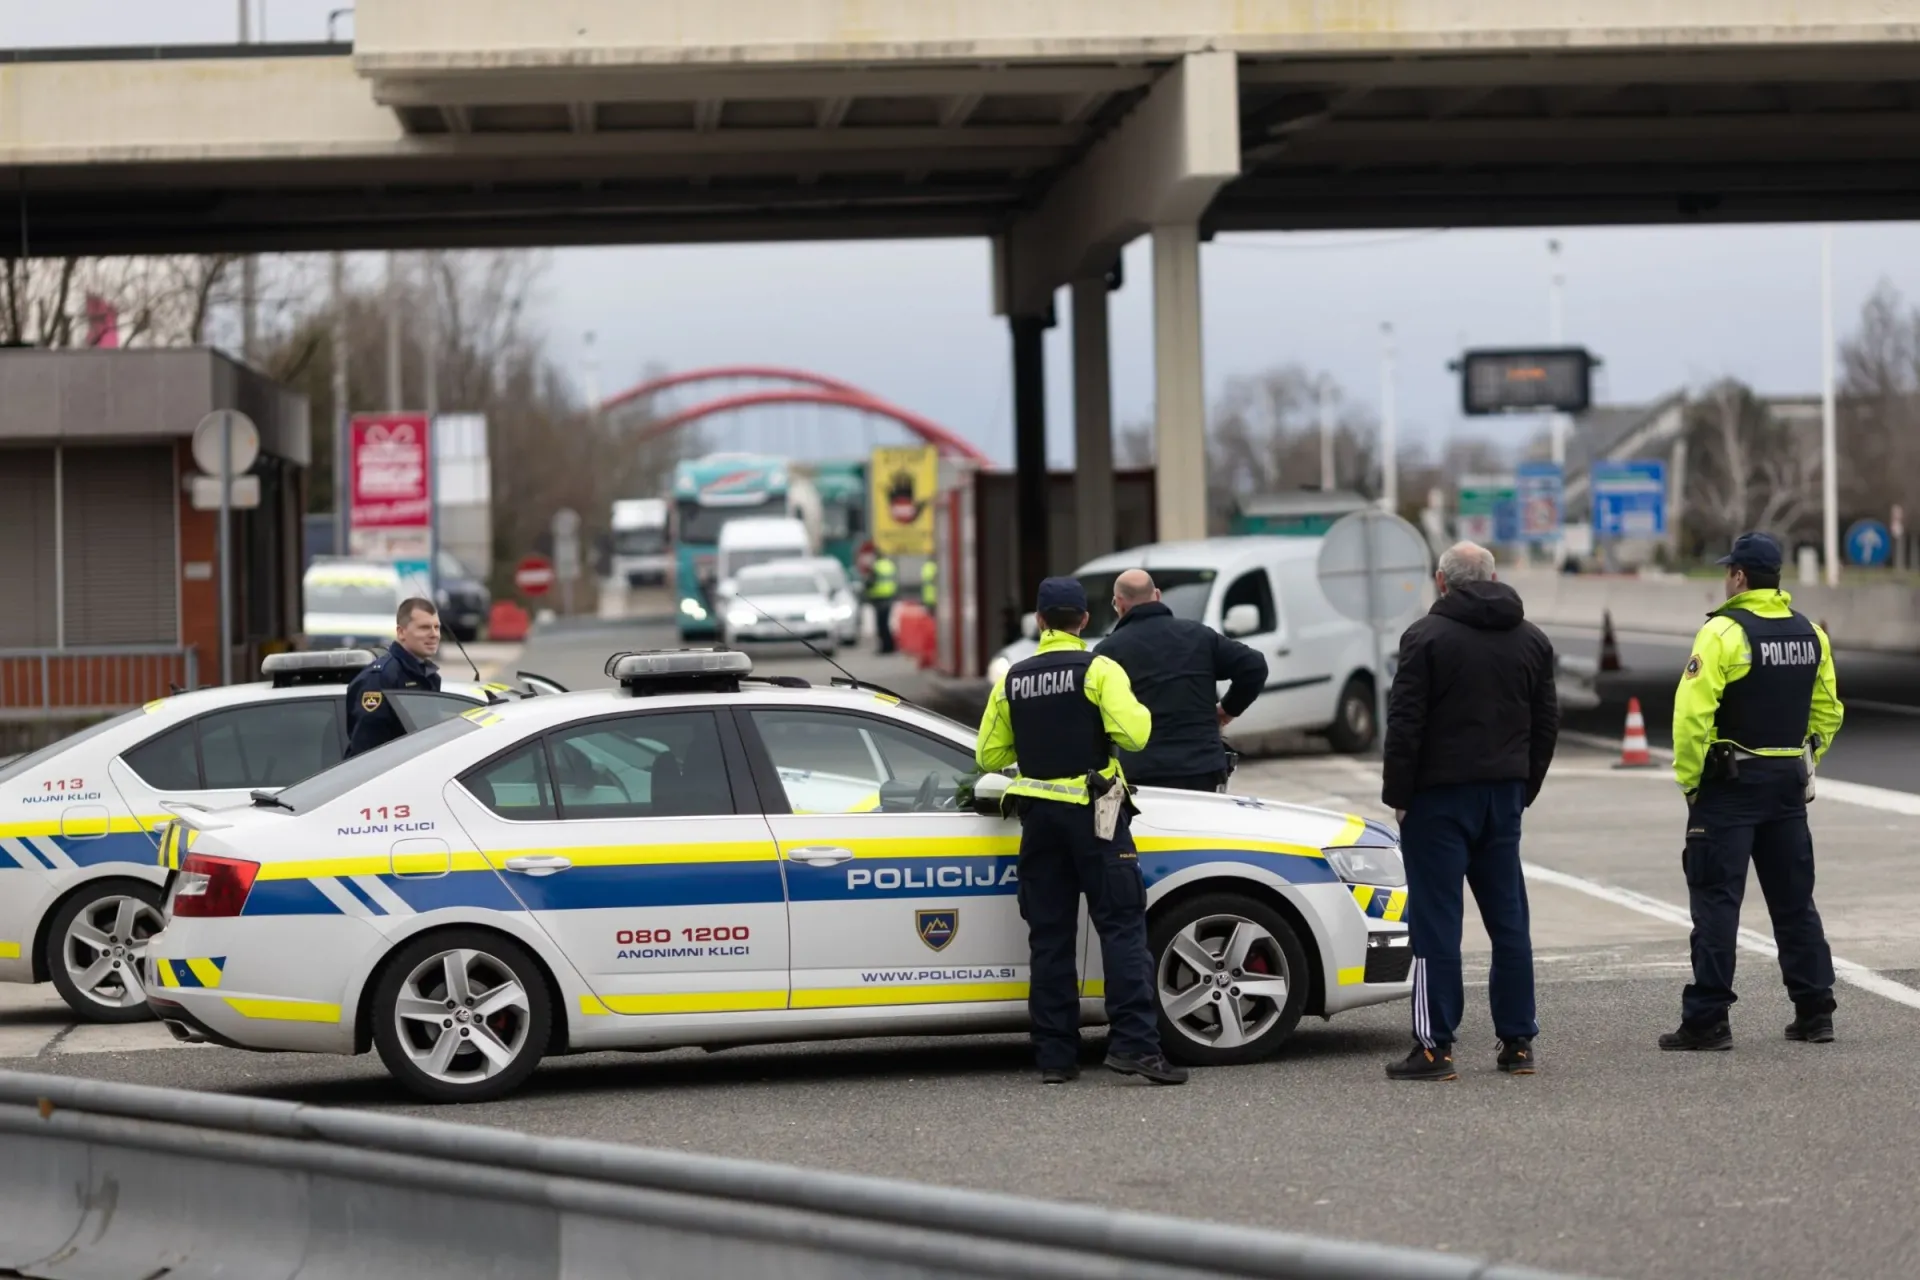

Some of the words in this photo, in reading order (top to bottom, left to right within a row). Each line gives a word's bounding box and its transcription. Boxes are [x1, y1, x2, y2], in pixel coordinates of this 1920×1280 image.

[1760, 641, 1816, 666] POLICIJA
[1011, 669, 1075, 700] POLICIJA
[43, 778, 84, 791] 113
[22, 794, 64, 804] NUJNI
[67, 792, 101, 801] KLICI
[360, 804, 411, 820] 113
[337, 824, 388, 836] NUJNI
[393, 821, 435, 833] KLICI
[847, 864, 1019, 890] POLICIJA
[616, 928, 672, 946] 080
[681, 926, 750, 943] 1200
[616, 947, 704, 960] ANONIMNI
[708, 945, 750, 957] KLICI
[861, 968, 1016, 983] WWW.POLICIJA.SI
